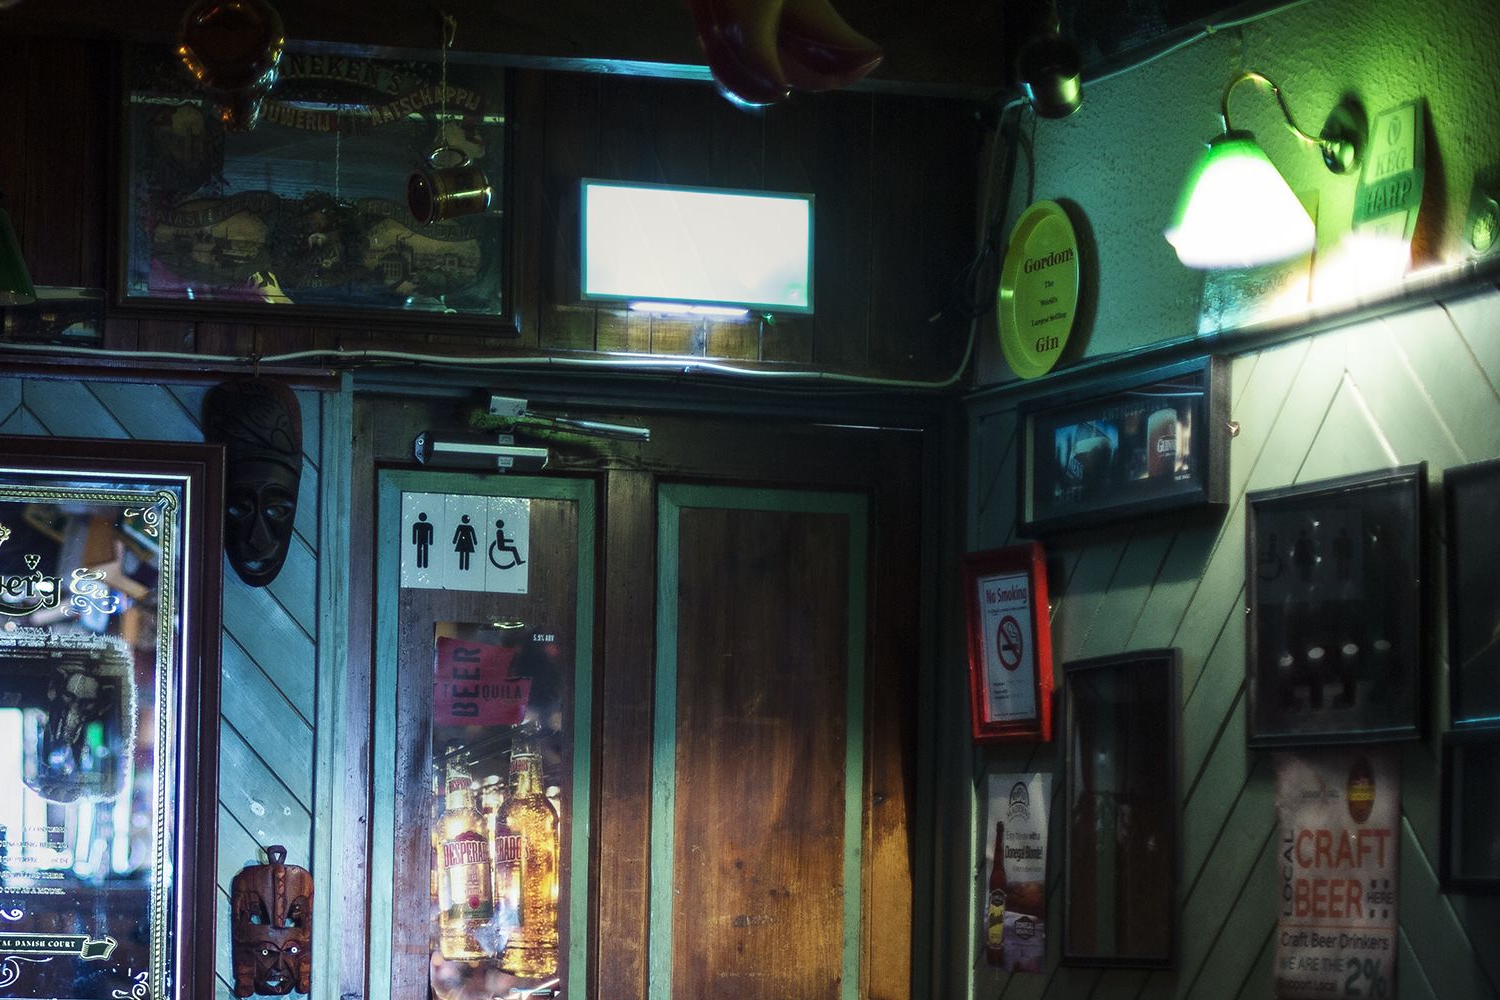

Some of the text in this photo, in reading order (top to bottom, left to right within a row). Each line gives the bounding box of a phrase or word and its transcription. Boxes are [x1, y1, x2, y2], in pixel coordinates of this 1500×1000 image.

[1376, 147, 1407, 177] KEG
[1365, 178, 1412, 217] HARP
[1035, 336, 1059, 353] Gin
[986, 583, 1028, 604] No Smoking
[452, 646, 481, 717] BEER
[1296, 829, 1392, 869] CRAFT
[1283, 829, 1295, 917] LOCAL
[1294, 878, 1364, 918] BEER
[1368, 891, 1394, 905] HERE
[1282, 932, 1389, 950] Craft Beer Drinkers
[1298, 957, 1319, 970] ARE
[1345, 957, 1388, 998] 2%
